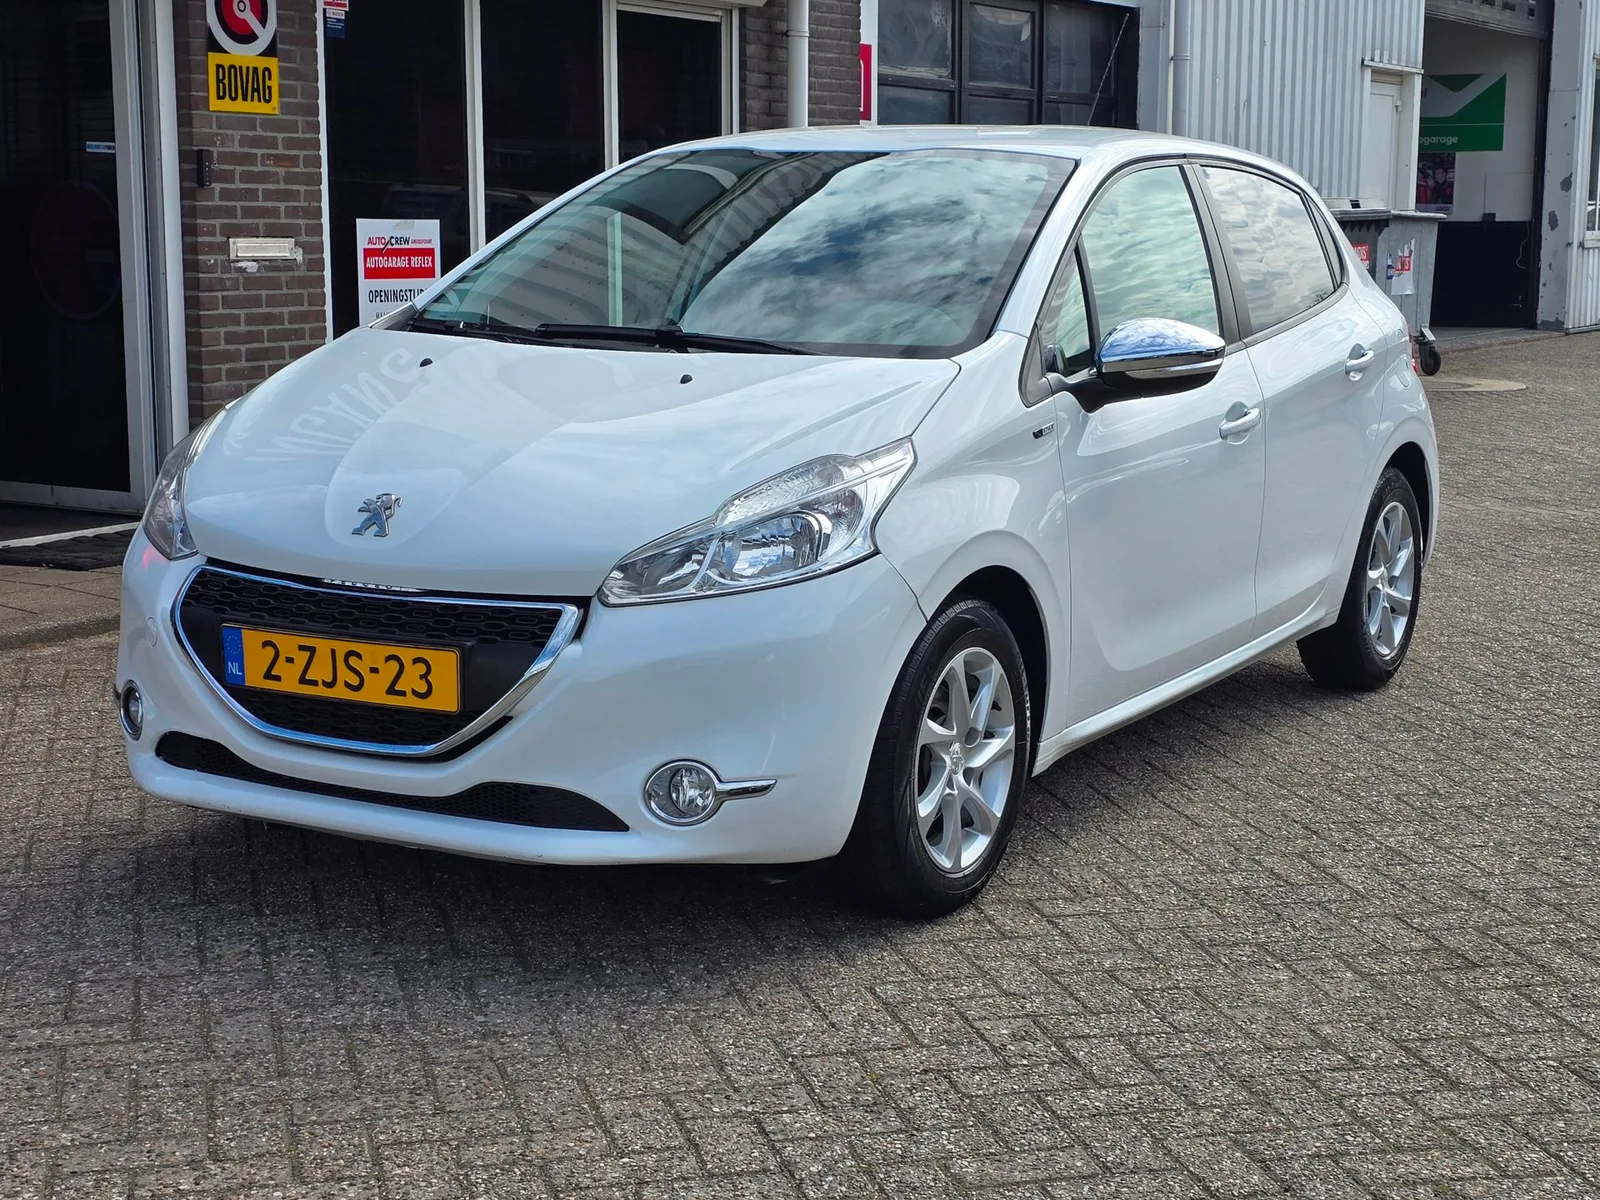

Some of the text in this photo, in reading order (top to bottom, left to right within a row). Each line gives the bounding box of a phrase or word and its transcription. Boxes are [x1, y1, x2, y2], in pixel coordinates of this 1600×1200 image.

[215, 64, 272, 104] BOVAG
[389, 235, 411, 246] CREW
[366, 256, 432, 268] AUTOGARAGE REFLEX
[227, 639, 433, 700] NL 2-ZJS-23
